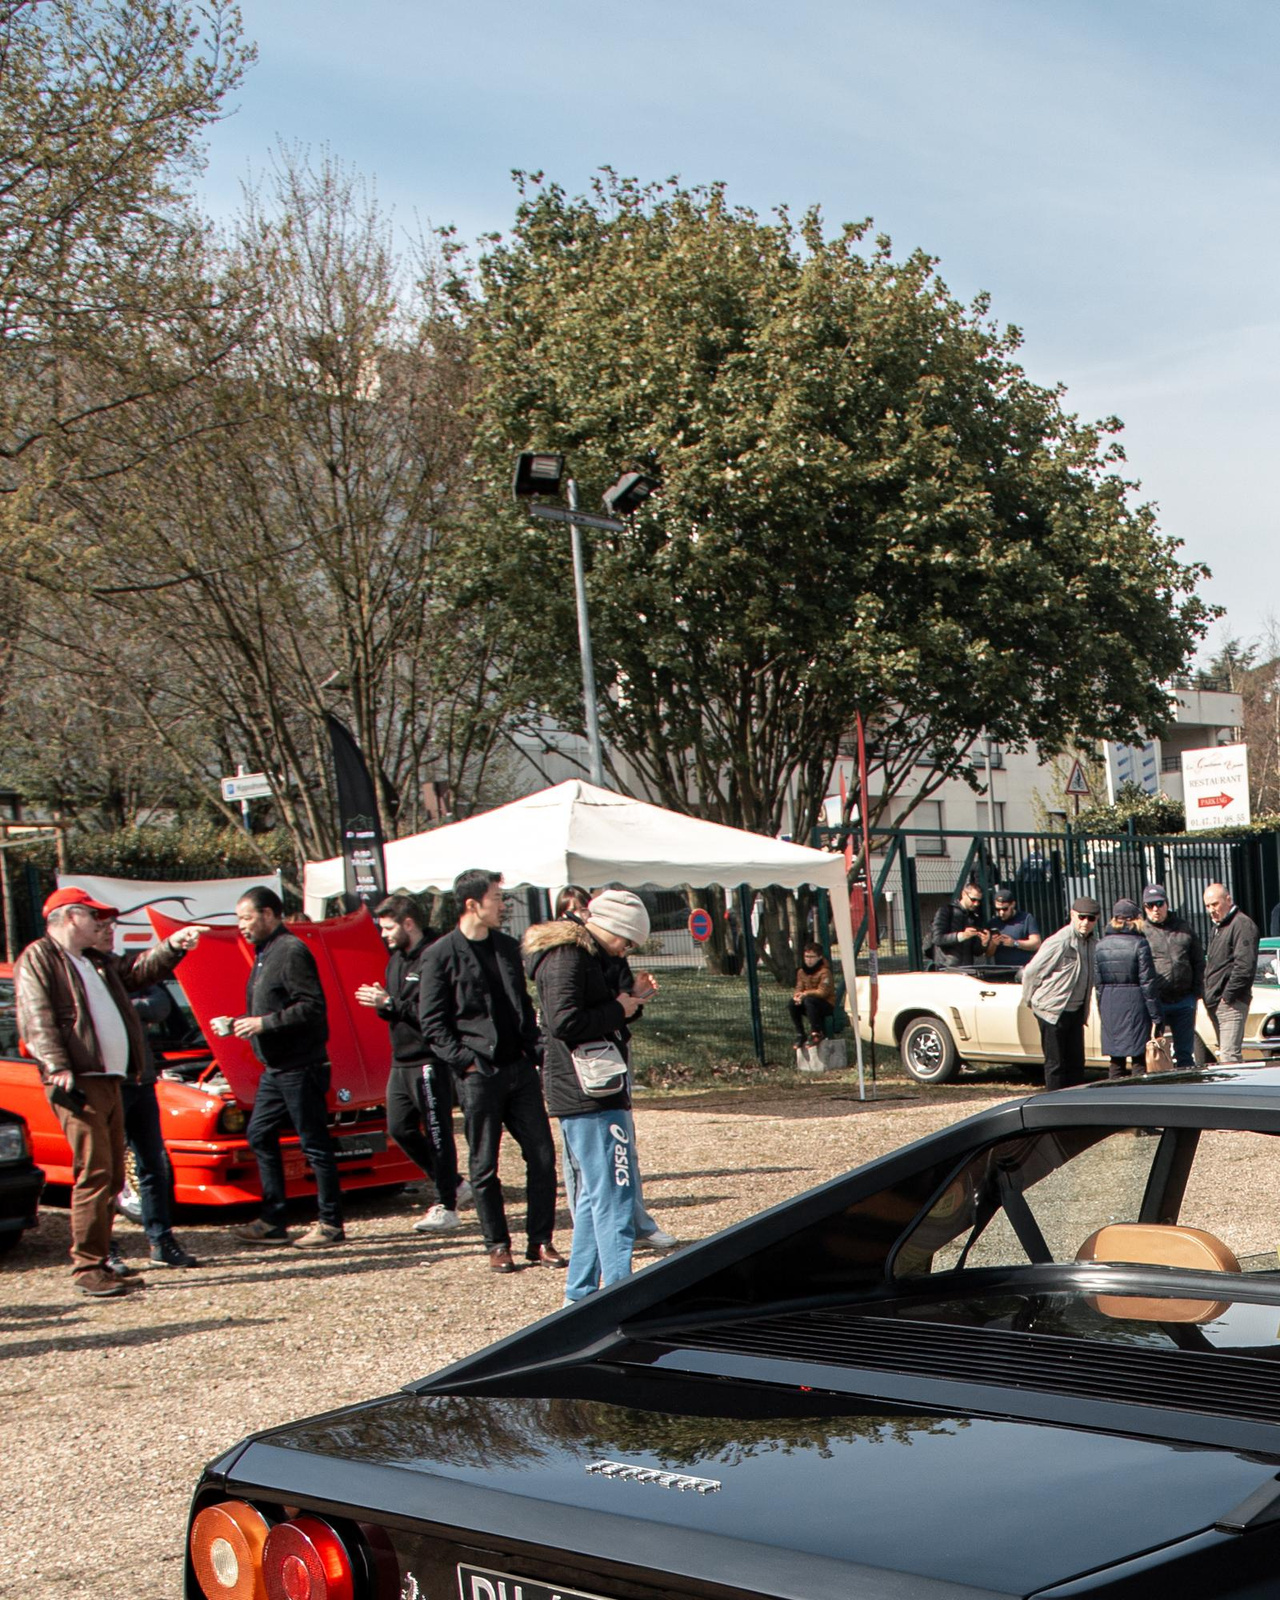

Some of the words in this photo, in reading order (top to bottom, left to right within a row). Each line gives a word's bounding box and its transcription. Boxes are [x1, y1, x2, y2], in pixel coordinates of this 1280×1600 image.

[1189, 775, 1242, 788] RESTAURANT
[1200, 796, 1228, 806] PARKING
[614, 1144, 630, 1187] asics
